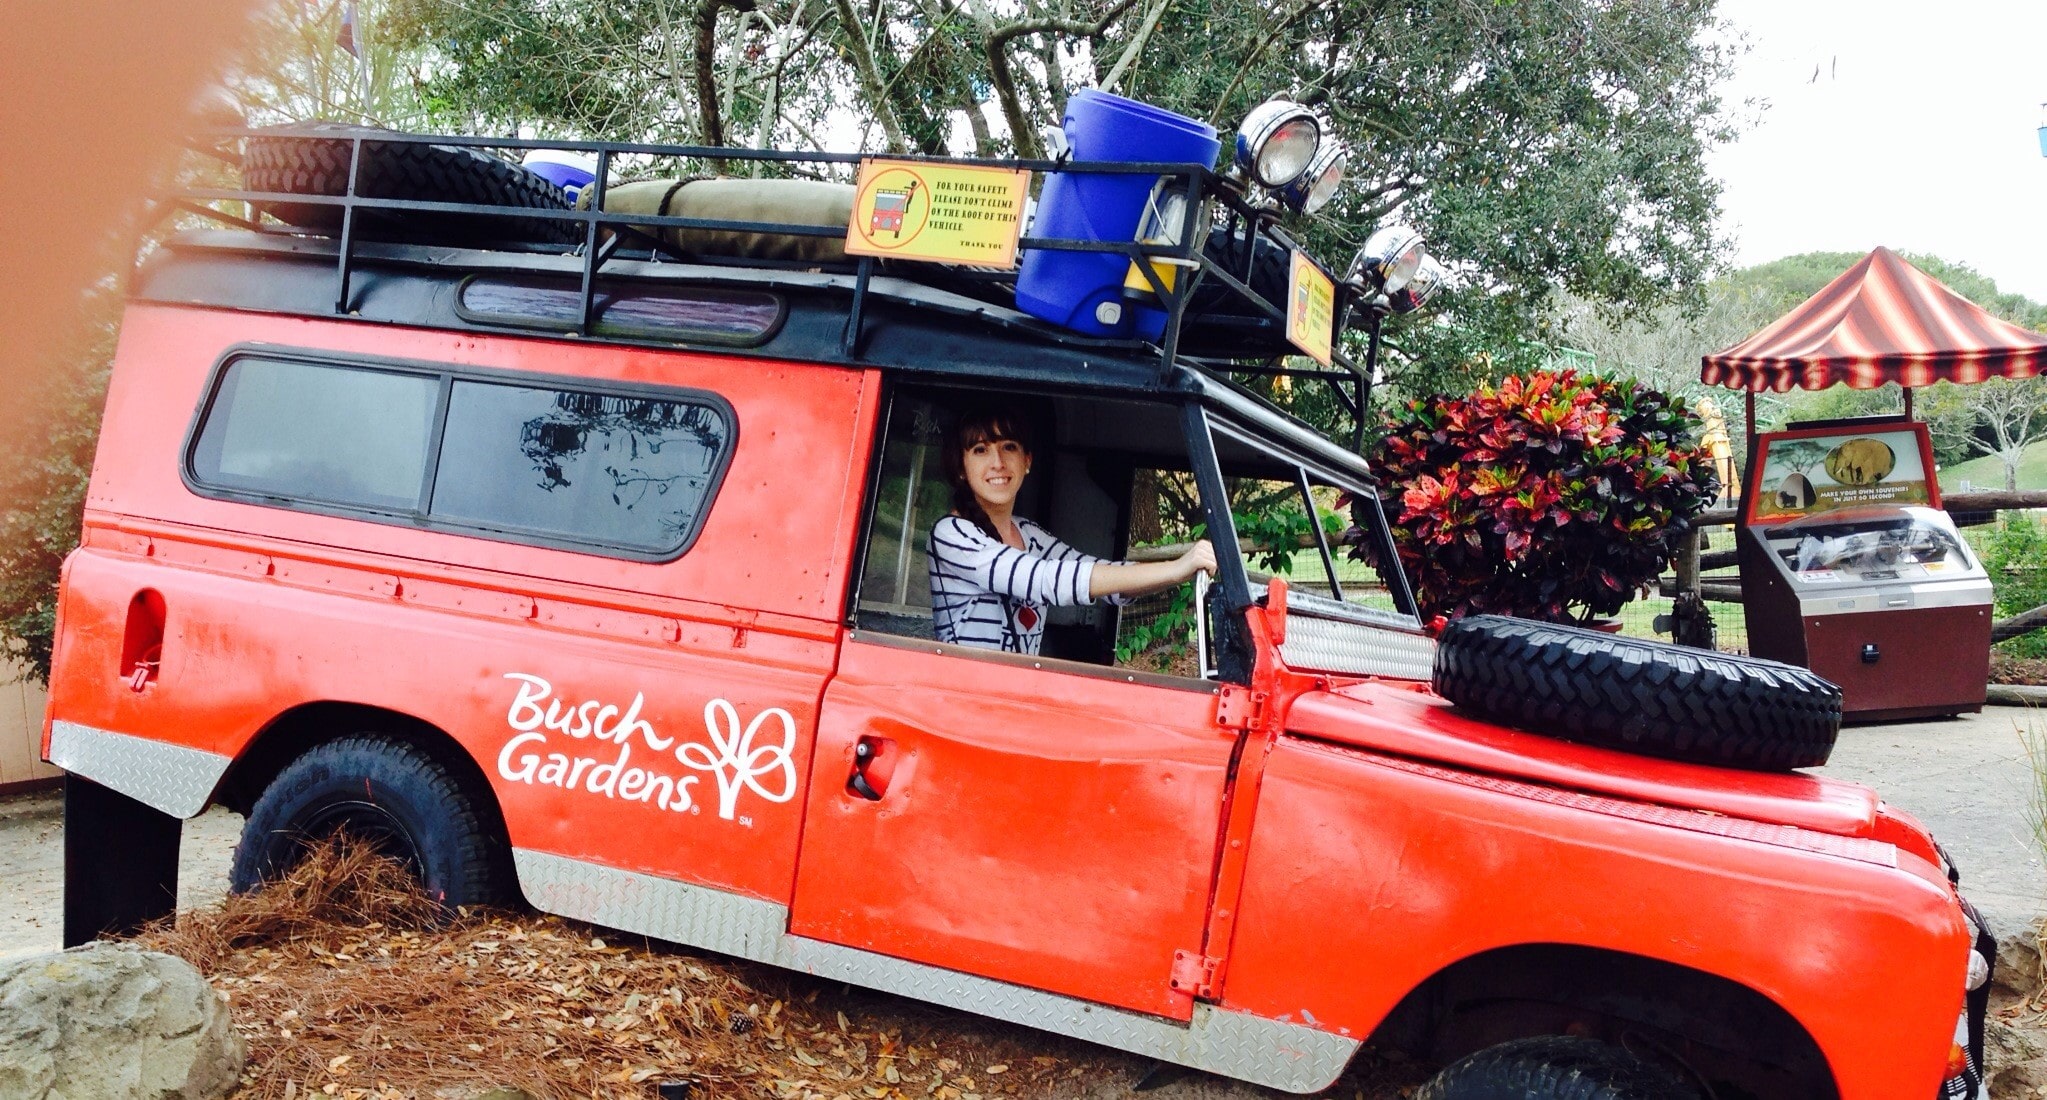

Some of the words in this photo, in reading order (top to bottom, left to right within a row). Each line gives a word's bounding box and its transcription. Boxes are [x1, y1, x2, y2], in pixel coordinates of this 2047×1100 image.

[936, 182, 952, 190] FOR
[954, 182, 974, 192] YOUR
[977, 184, 1008, 195] SAFETY
[934, 194, 962, 204] PLEASE
[964, 196, 986, 206] DON'T
[988, 199, 1014, 208] CLIMB
[931, 208, 942, 216] ON
[944, 208, 960, 218] THE
[962, 210, 984, 220] ROOF
[984, 212, 995, 220] OF
[996, 213, 1017, 222] THIS
[960, 240, 985, 248] THANK
[503, 672, 674, 750] Busch
